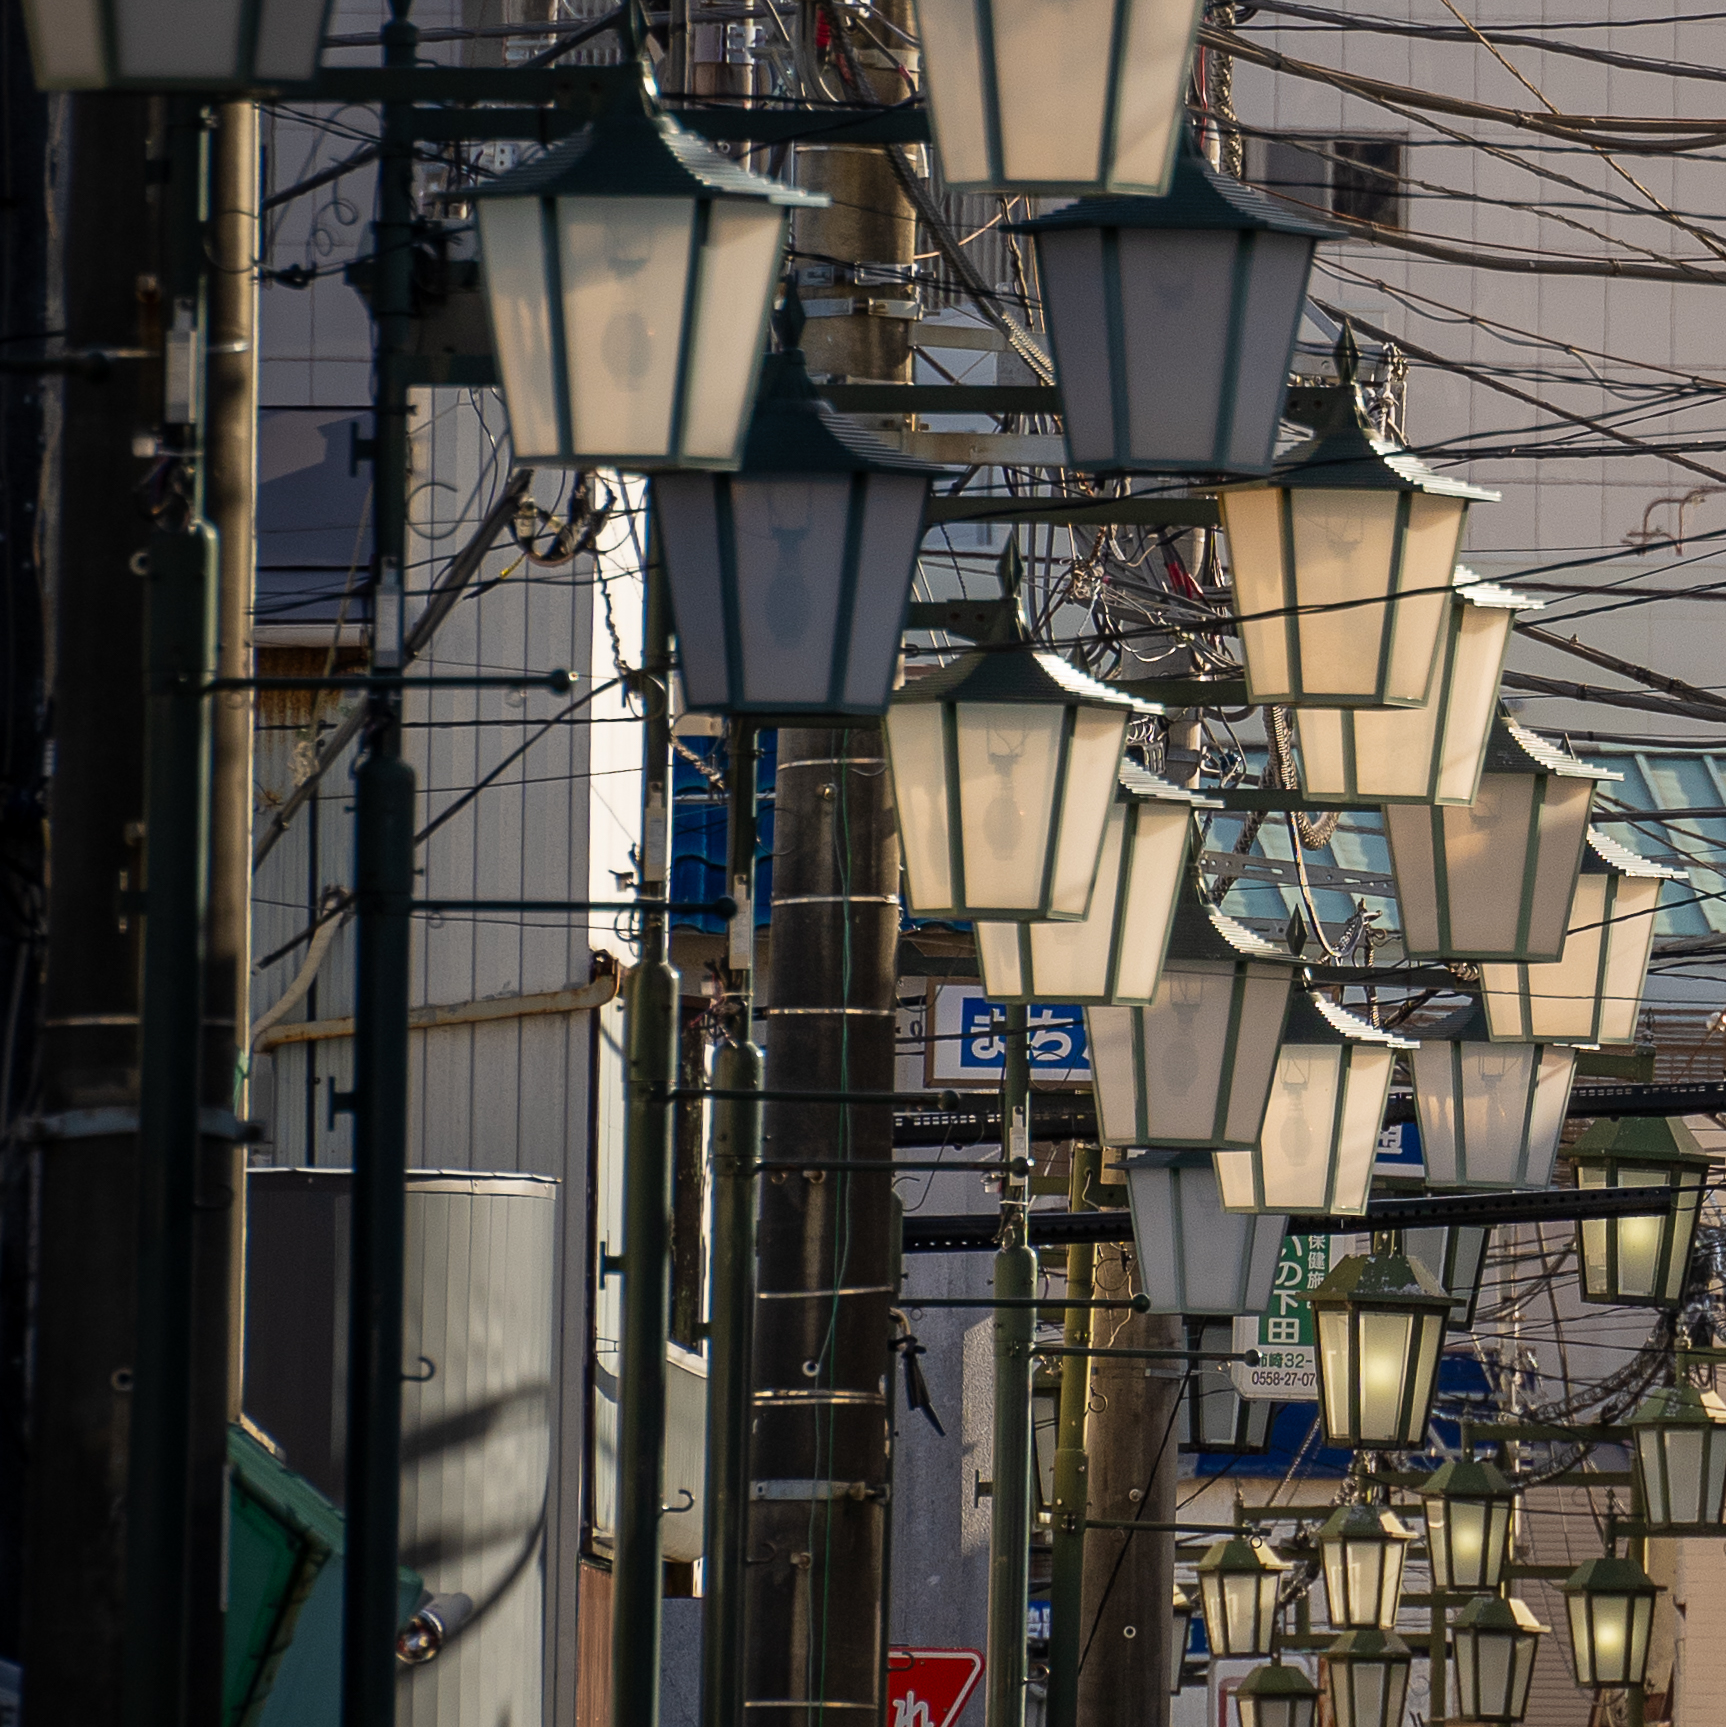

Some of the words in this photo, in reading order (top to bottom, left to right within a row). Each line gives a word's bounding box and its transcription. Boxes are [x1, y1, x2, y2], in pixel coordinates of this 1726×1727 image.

[969, 1006, 1091, 1062] まち
[1305, 1235, 1326, 1309] 保健施
